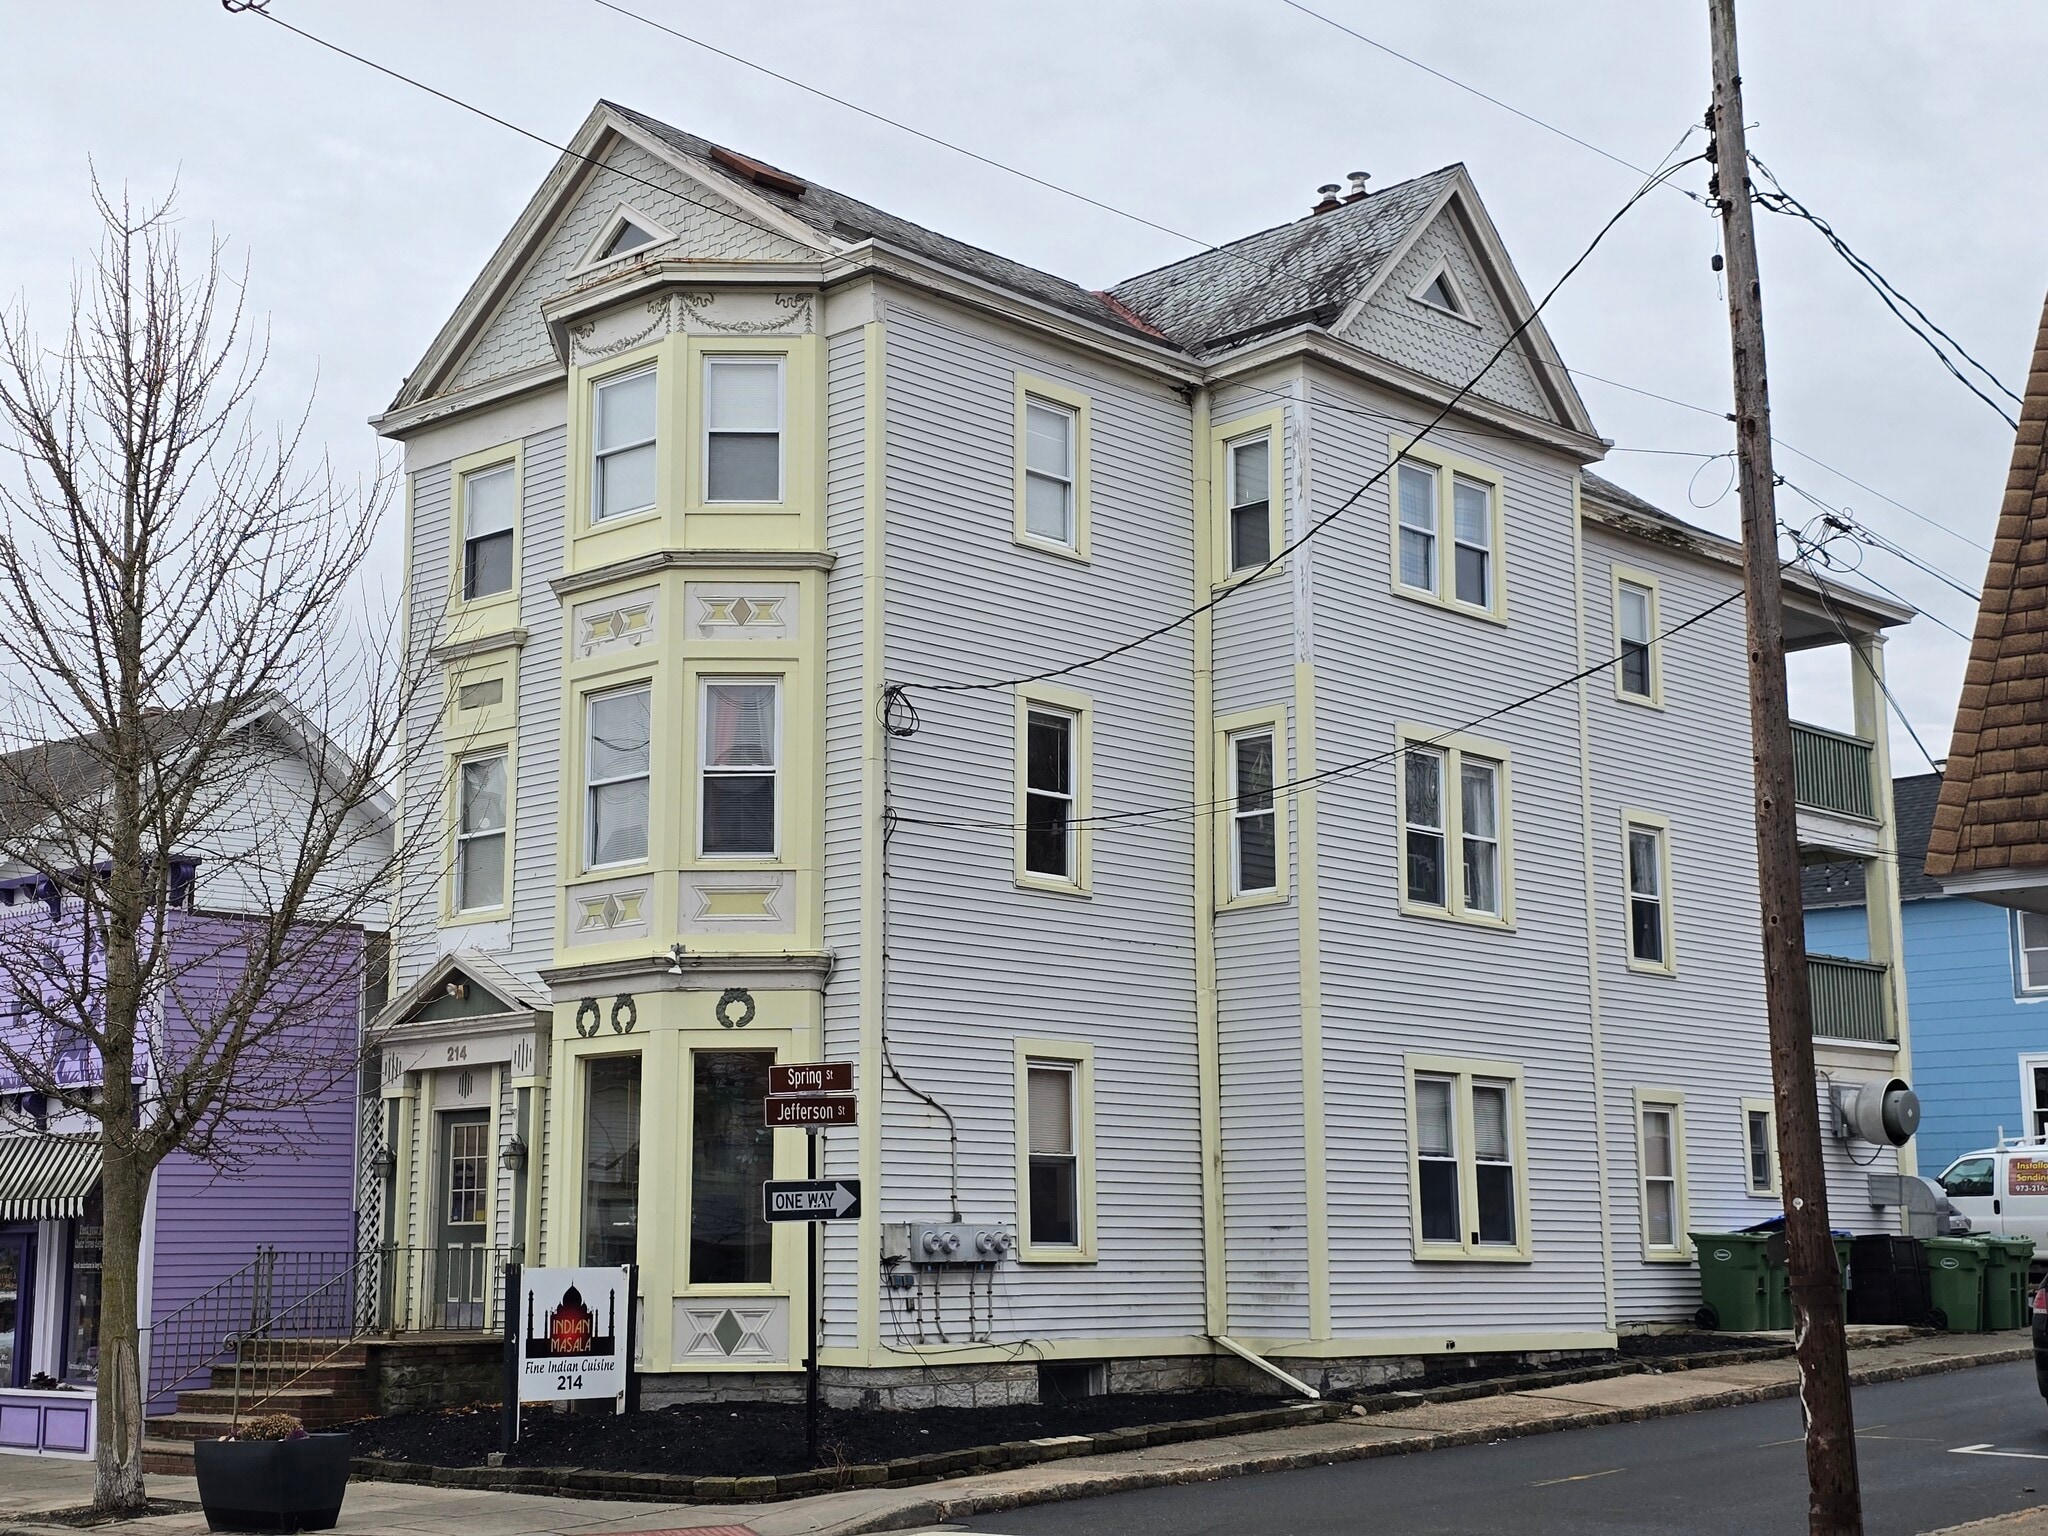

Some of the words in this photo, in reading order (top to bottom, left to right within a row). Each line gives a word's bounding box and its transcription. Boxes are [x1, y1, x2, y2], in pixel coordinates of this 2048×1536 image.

[447, 1045, 467, 1062] 214
[788, 1068, 822, 1089] Spring
[826, 1069, 834, 1080] St
[777, 1103, 833, 1121] Jefferson
[837, 1105, 846, 1116] St
[775, 1193, 803, 1210] ONE
[808, 1192, 835, 1208] WAY
[553, 1319, 590, 1334] INDIAN
[551, 1338, 591, 1352] MASALA
[525, 1361, 545, 1375] Fine
[548, 1360, 579, 1374] Indian
[581, 1359, 615, 1372] Cuisine
[557, 1375, 583, 1390] 214
